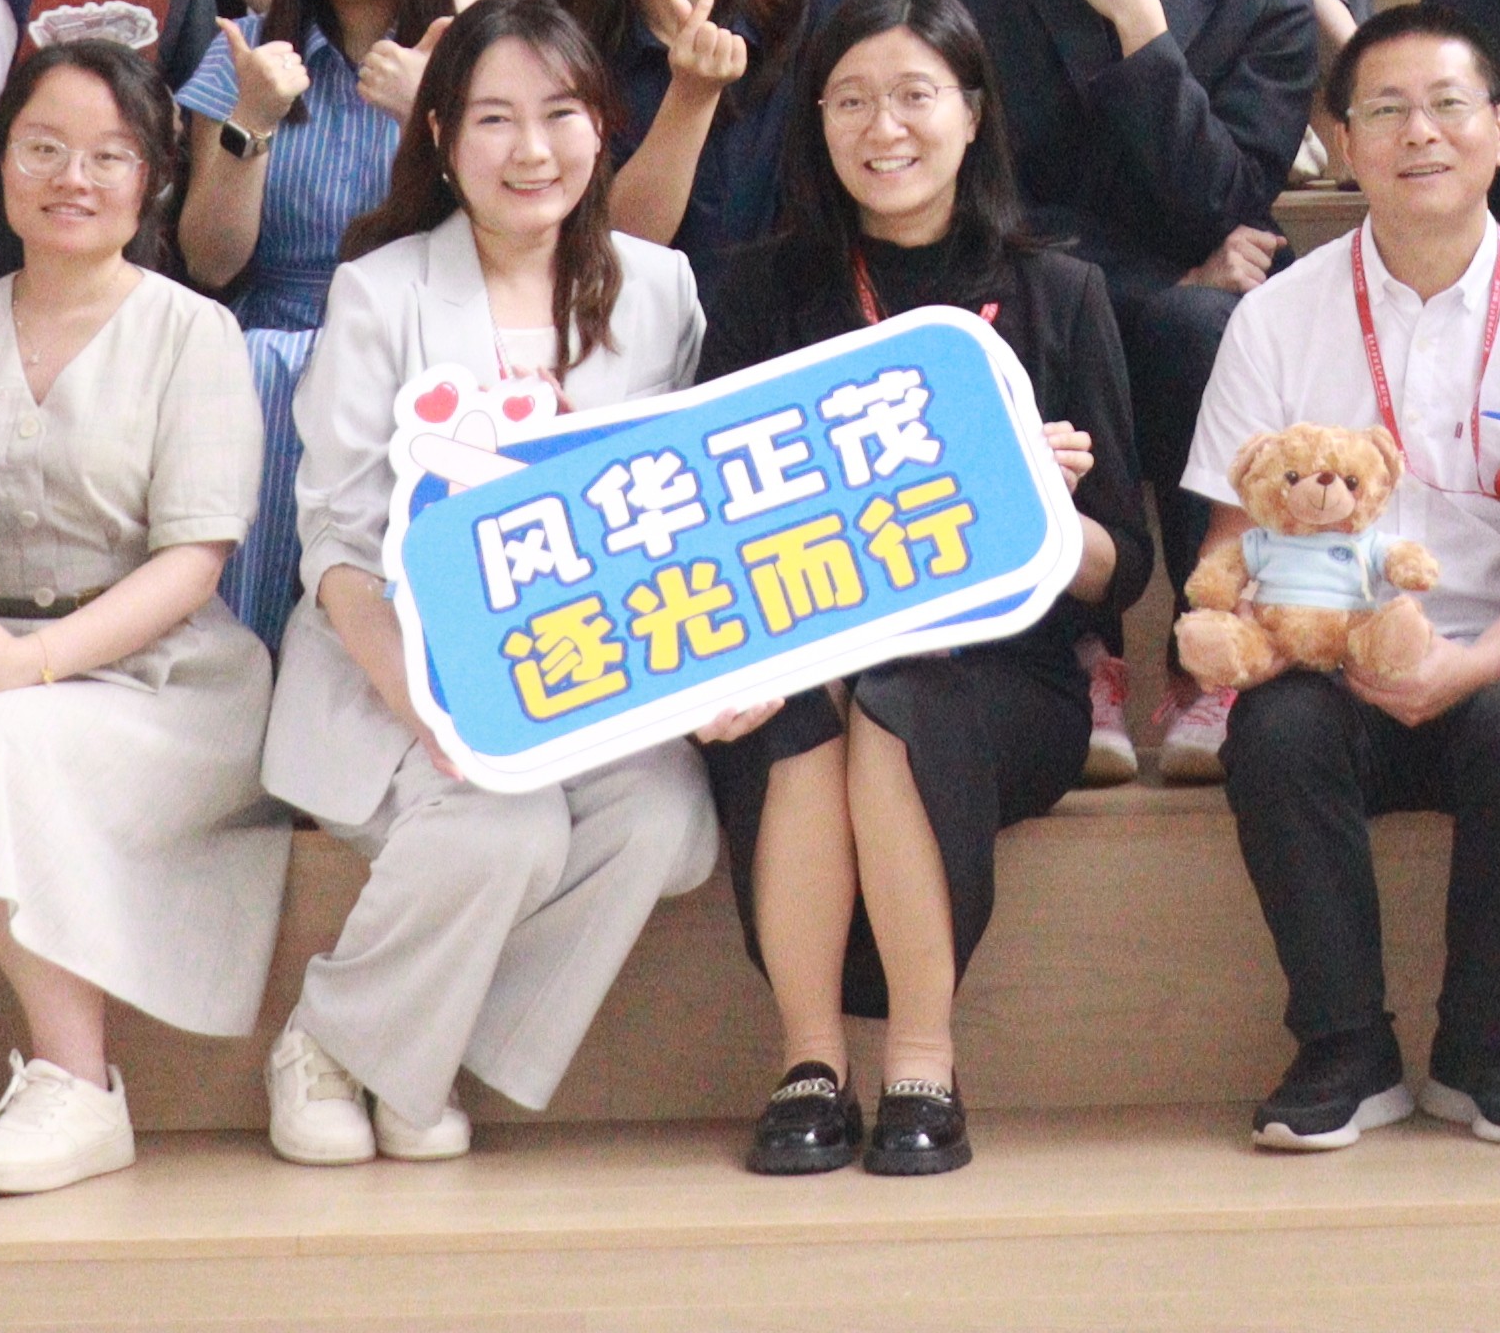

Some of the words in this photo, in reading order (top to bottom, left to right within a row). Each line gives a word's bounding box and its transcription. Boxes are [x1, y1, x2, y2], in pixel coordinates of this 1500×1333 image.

[475, 367, 945, 612] 风华正茂
[501, 476, 976, 722] 逐光而行
